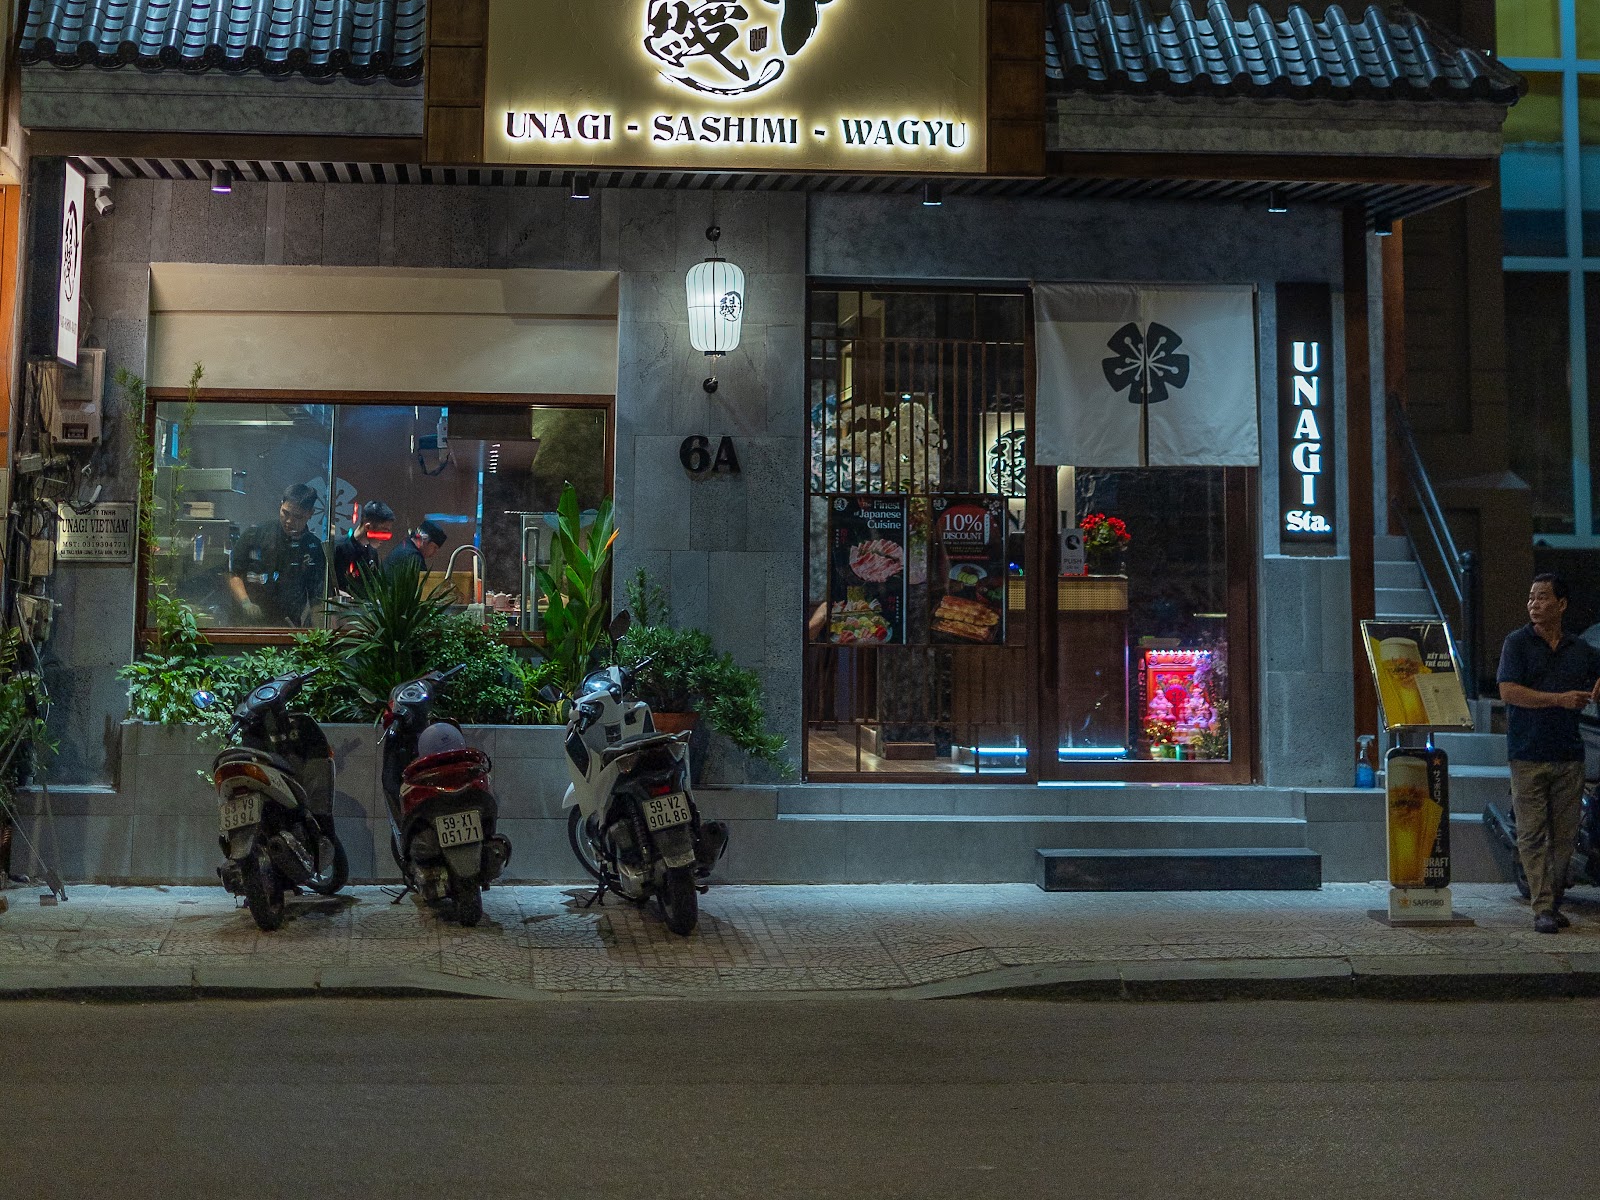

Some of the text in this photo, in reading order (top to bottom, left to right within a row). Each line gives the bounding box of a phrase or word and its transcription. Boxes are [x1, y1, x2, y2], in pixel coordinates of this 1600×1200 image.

[506, 112, 612, 141] UNAGI
[653, 115, 798, 144] SASHIMI
[841, 118, 966, 148] WAGYU
[1291, 341, 1321, 505] UNAGI
[680, 434, 741, 474] 6A
[859, 509, 901, 519] Japanese
[873, 500, 900, 510] Finest
[62, 518, 129, 534] UNAGI VIETNAM
[867, 519, 901, 529] Cuisine
[944, 513, 983, 531] 10%
[1286, 510, 1332, 533] Sta.
[943, 532, 982, 540] DISCOUNT
[649, 796, 681, 814] 59-V2
[224, 810, 254, 828] 5994
[443, 813, 473, 830] 59-X1
[650, 808, 688, 828] 904.86
[442, 826, 480, 845] 051.71
[1424, 857, 1449, 868] DRAFT
[1424, 867, 1444, 878] BEER
